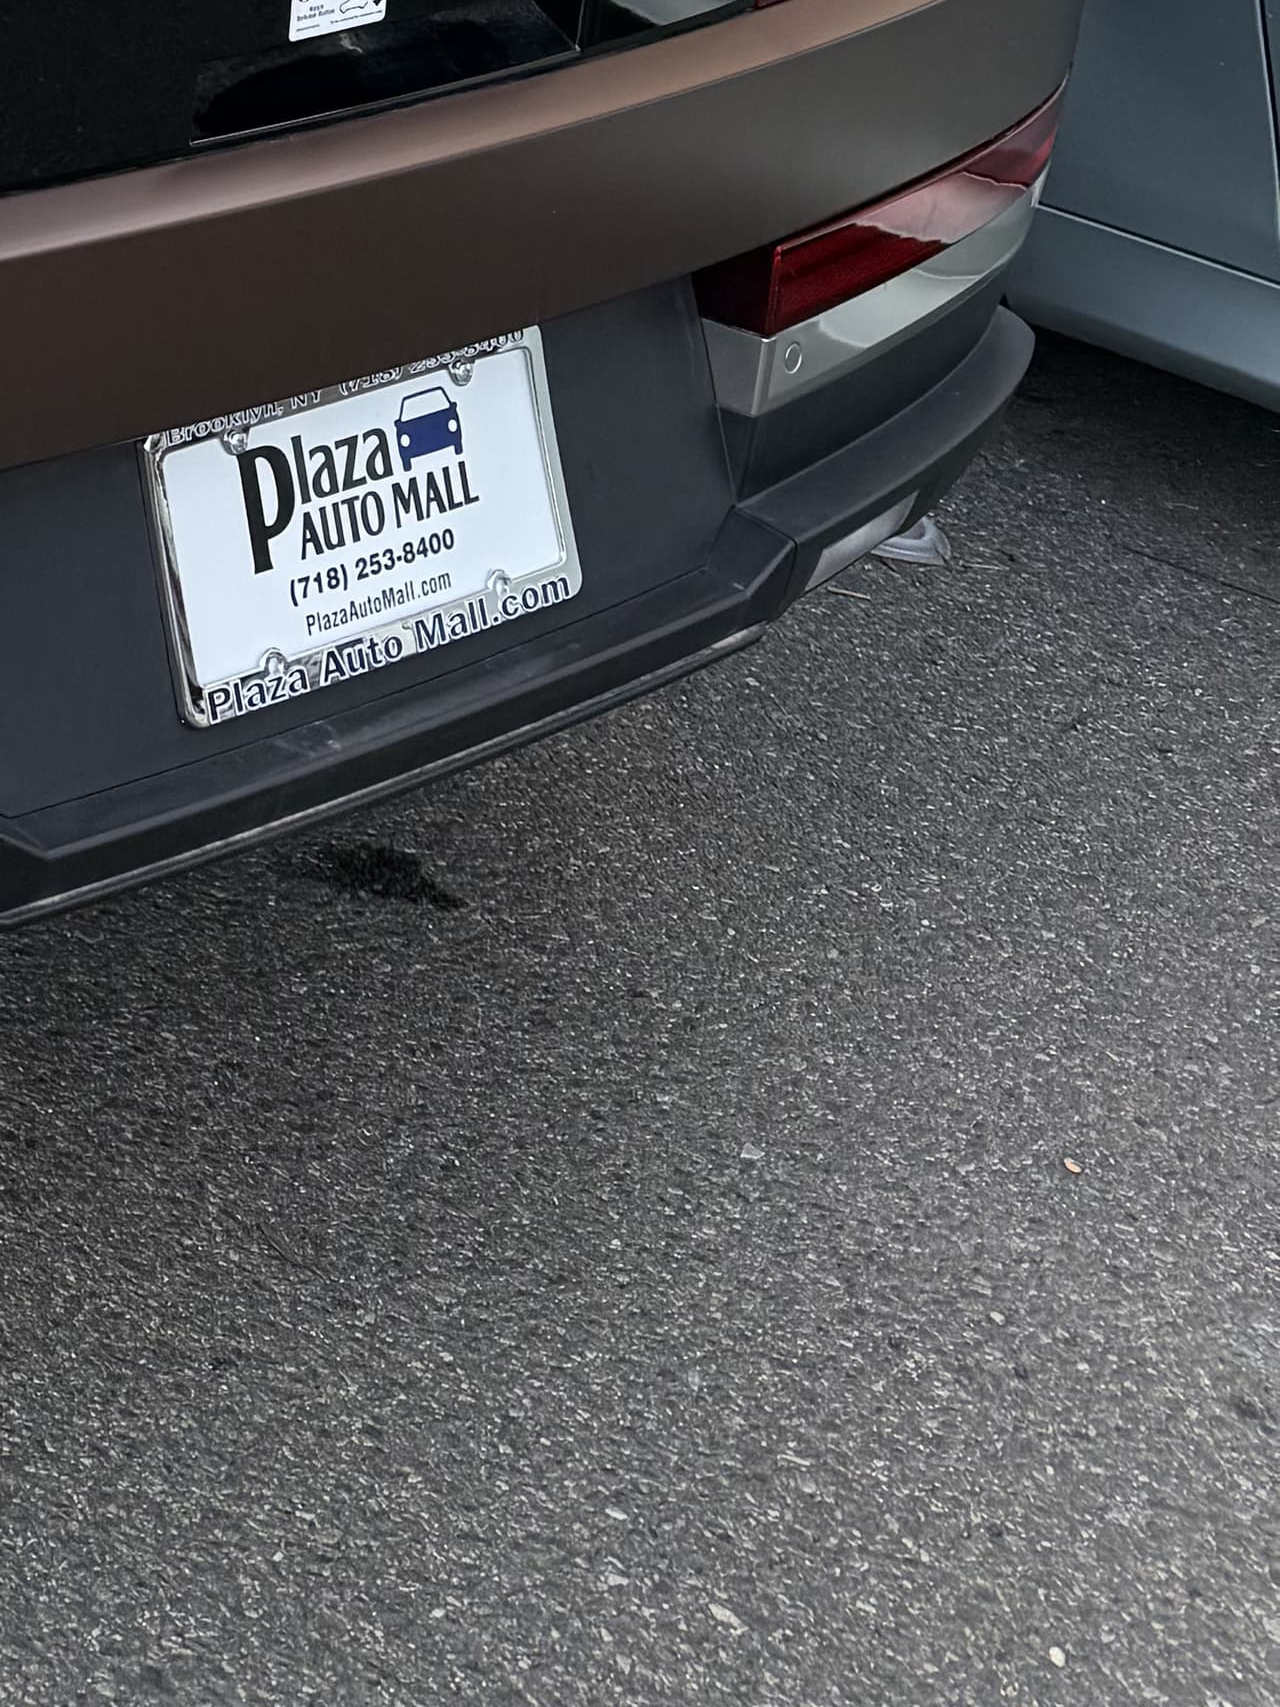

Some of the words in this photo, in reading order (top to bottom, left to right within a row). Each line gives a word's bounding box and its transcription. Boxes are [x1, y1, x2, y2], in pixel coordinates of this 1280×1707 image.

[237, 427, 395, 575] Plaza
[300, 488, 387, 560] AUTO
[393, 460, 480, 529] MALL
[289, 564, 350, 607] (718)
[354, 528, 456, 582] 253-8400
[305, 571, 453, 637] PlazaAutoMall.com
[206, 664, 309, 724] Plaza
[321, 632, 404, 686] Auto
[412, 573, 572, 652] Mall.com
